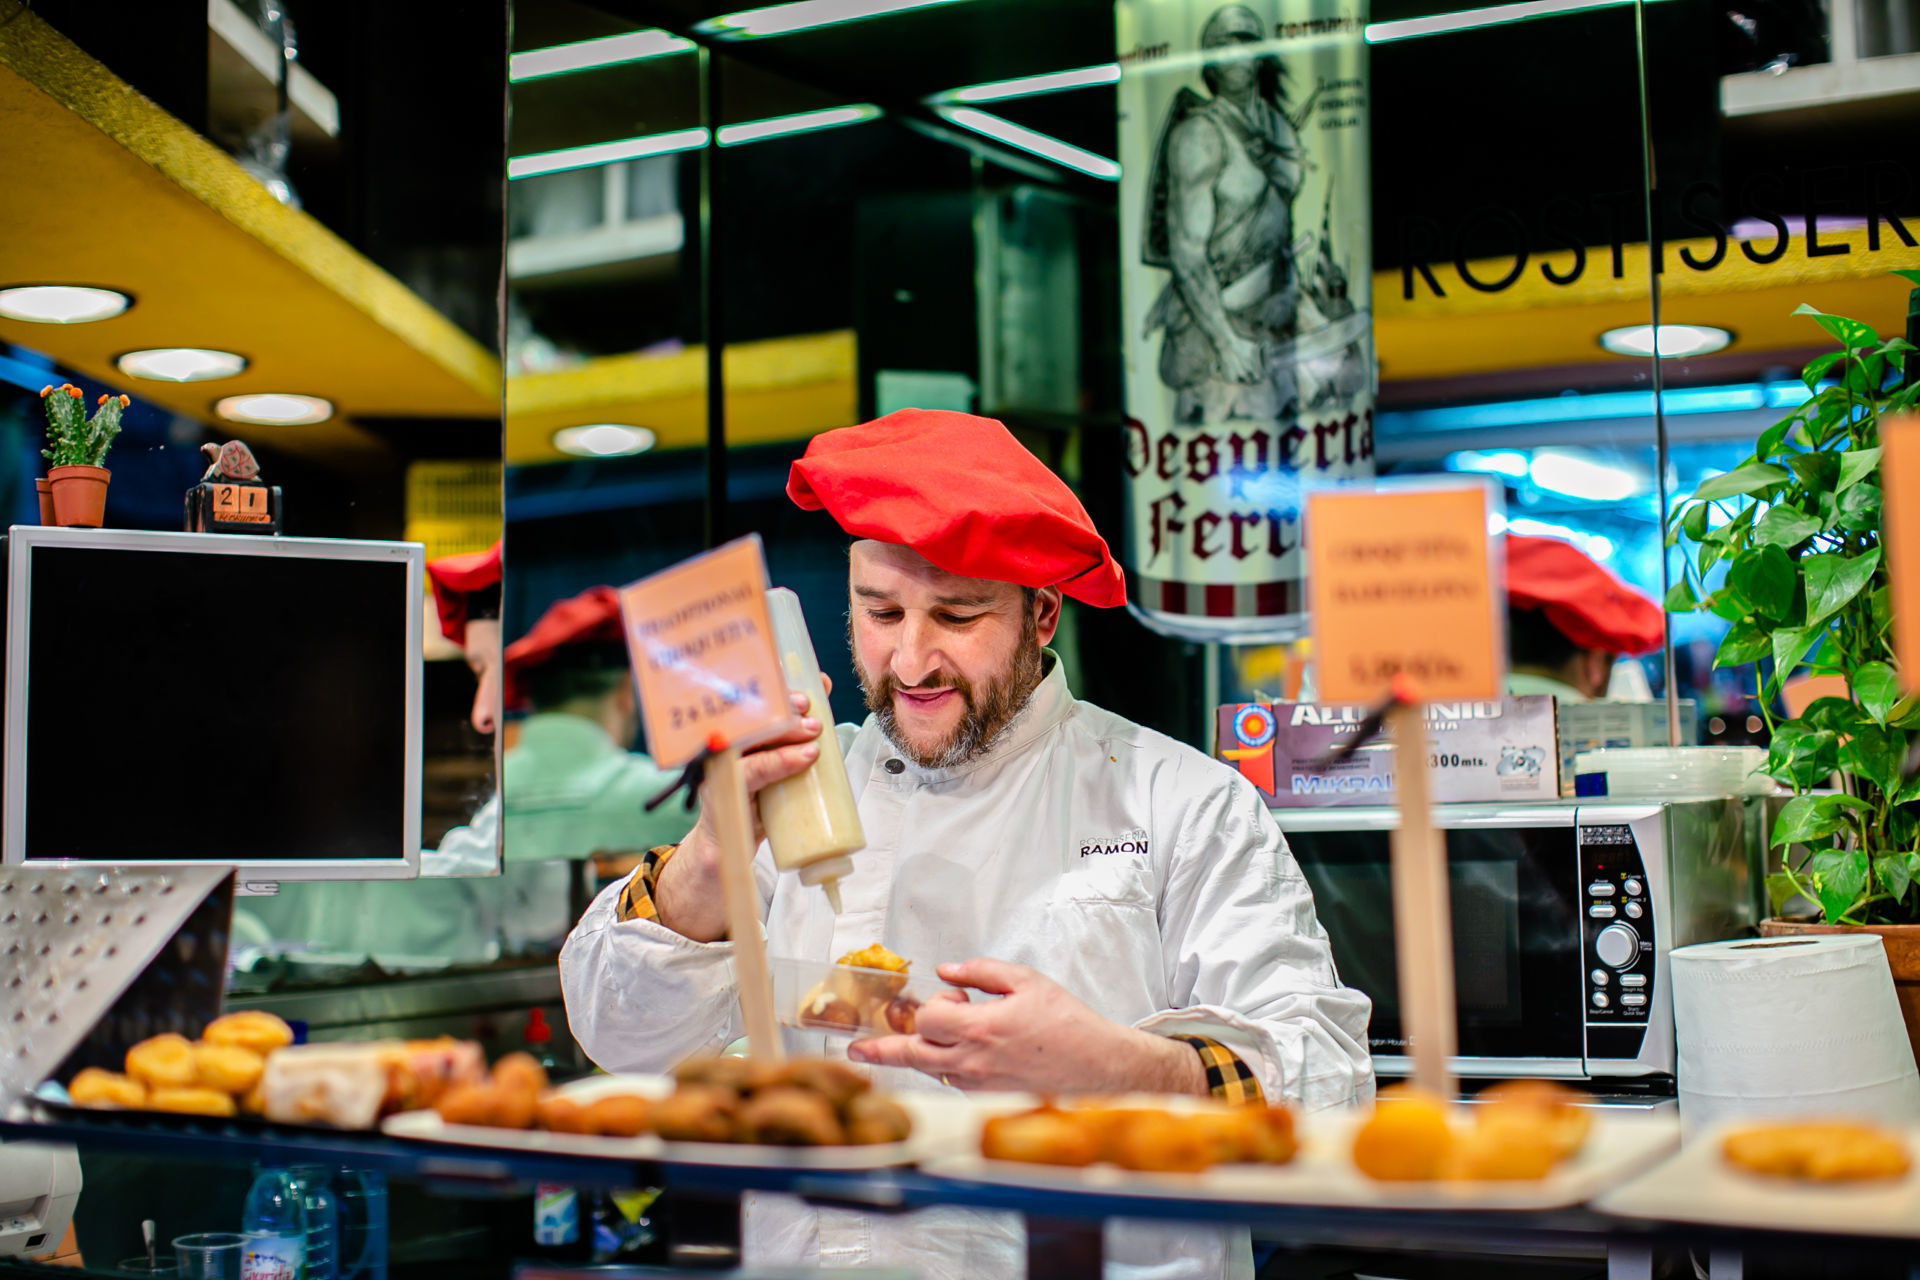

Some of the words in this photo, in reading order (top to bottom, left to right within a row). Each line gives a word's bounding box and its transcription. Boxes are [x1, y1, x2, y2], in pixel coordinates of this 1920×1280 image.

[1122, 407, 1375, 502] Desperta
[1147, 491, 1308, 570] Ferr
[1290, 701, 1503, 727] ALUNIO
[1080, 841, 1149, 858] RAMON
